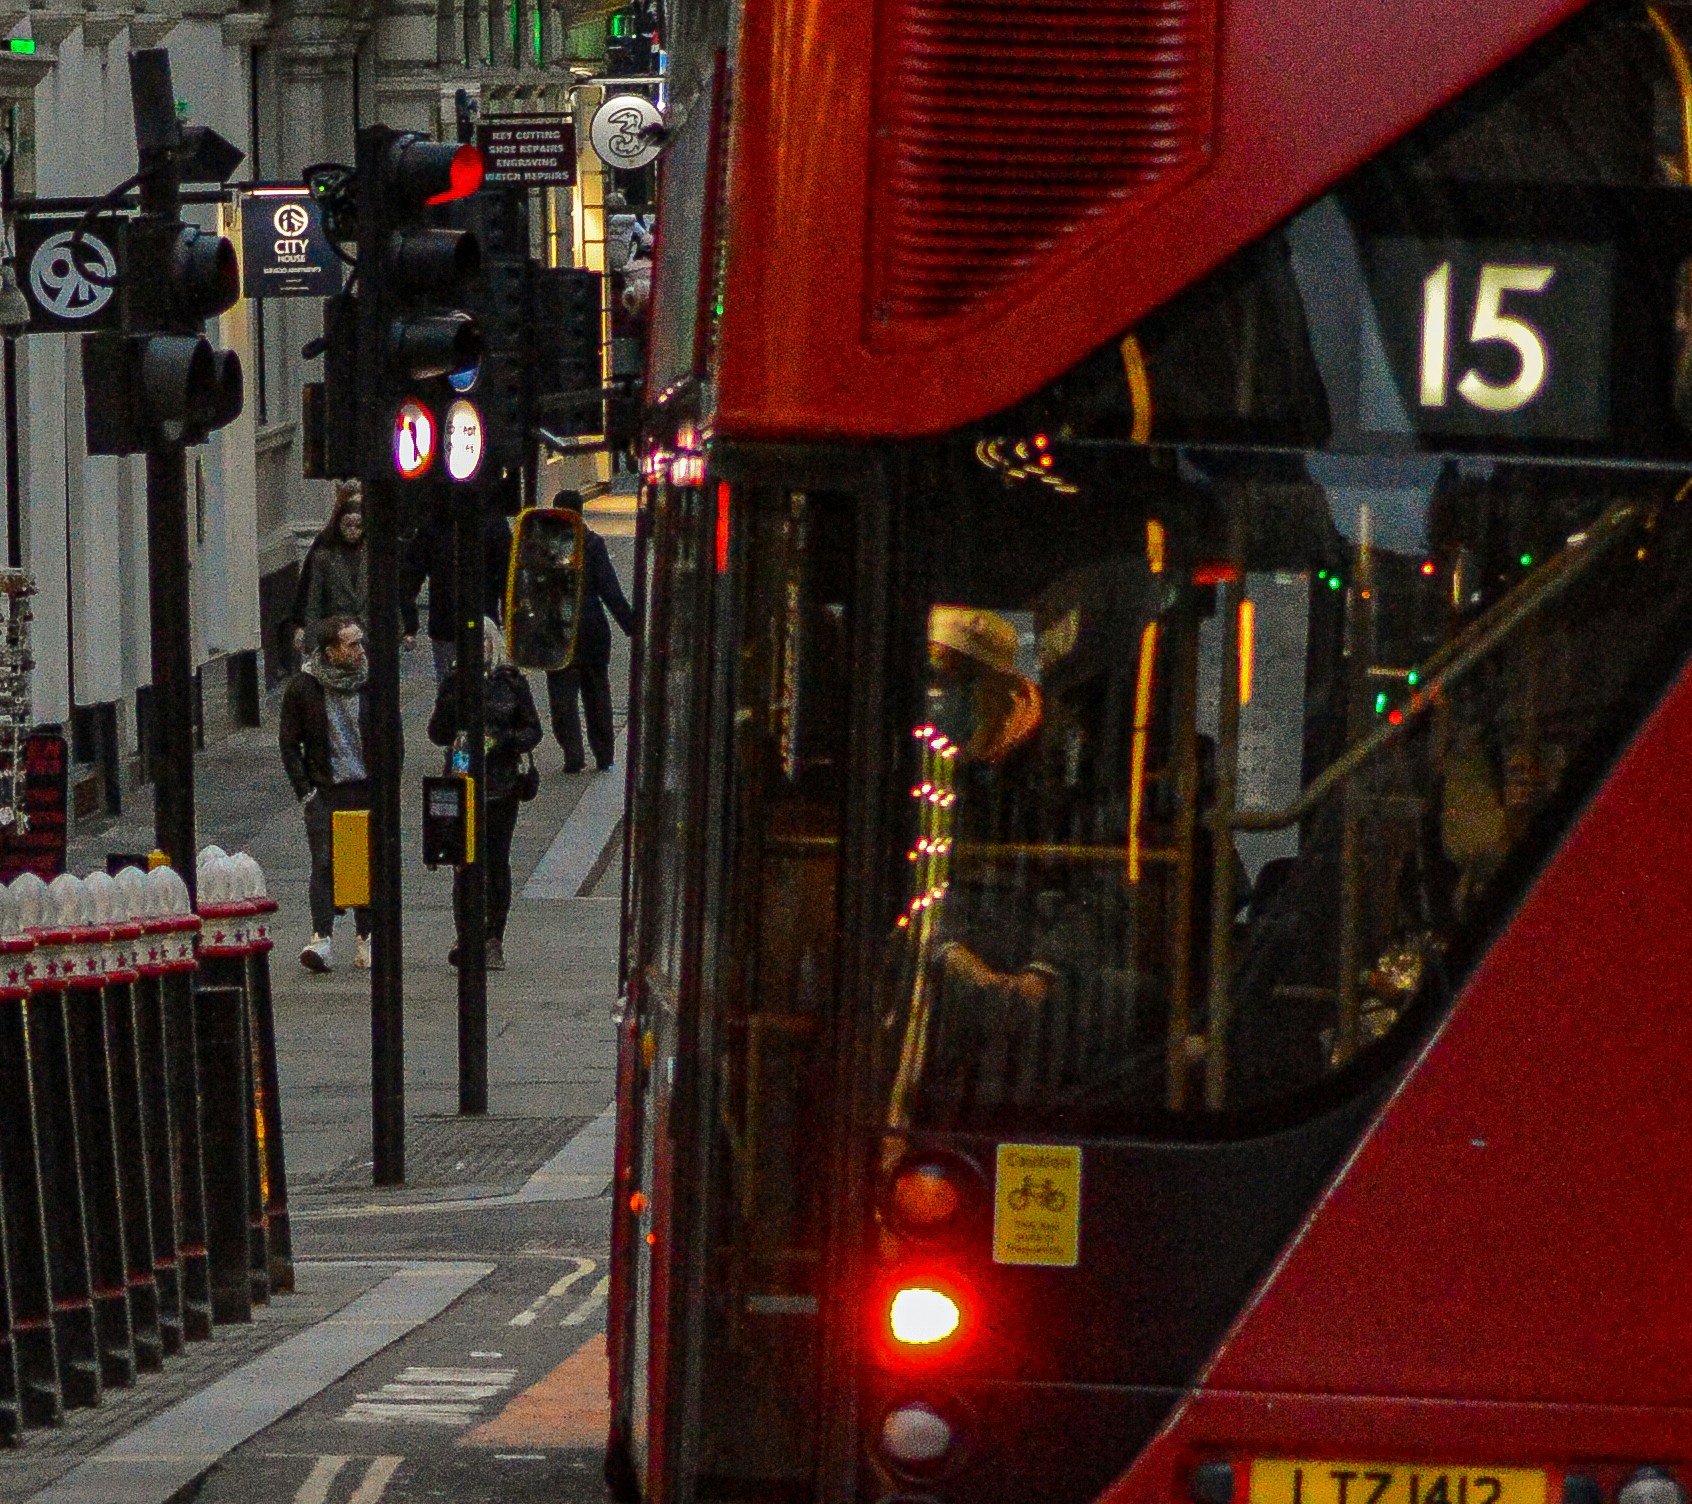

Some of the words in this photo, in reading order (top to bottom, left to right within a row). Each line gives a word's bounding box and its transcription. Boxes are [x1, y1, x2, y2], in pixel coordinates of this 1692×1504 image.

[493, 132, 512, 140] KEY
[516, 131, 560, 139] CUTTING
[497, 159, 557, 167] ENGRAVING
[524, 172, 569, 180] REPAIRS
[274, 239, 309, 254] CITY
[1421, 260, 1554, 410] 15
